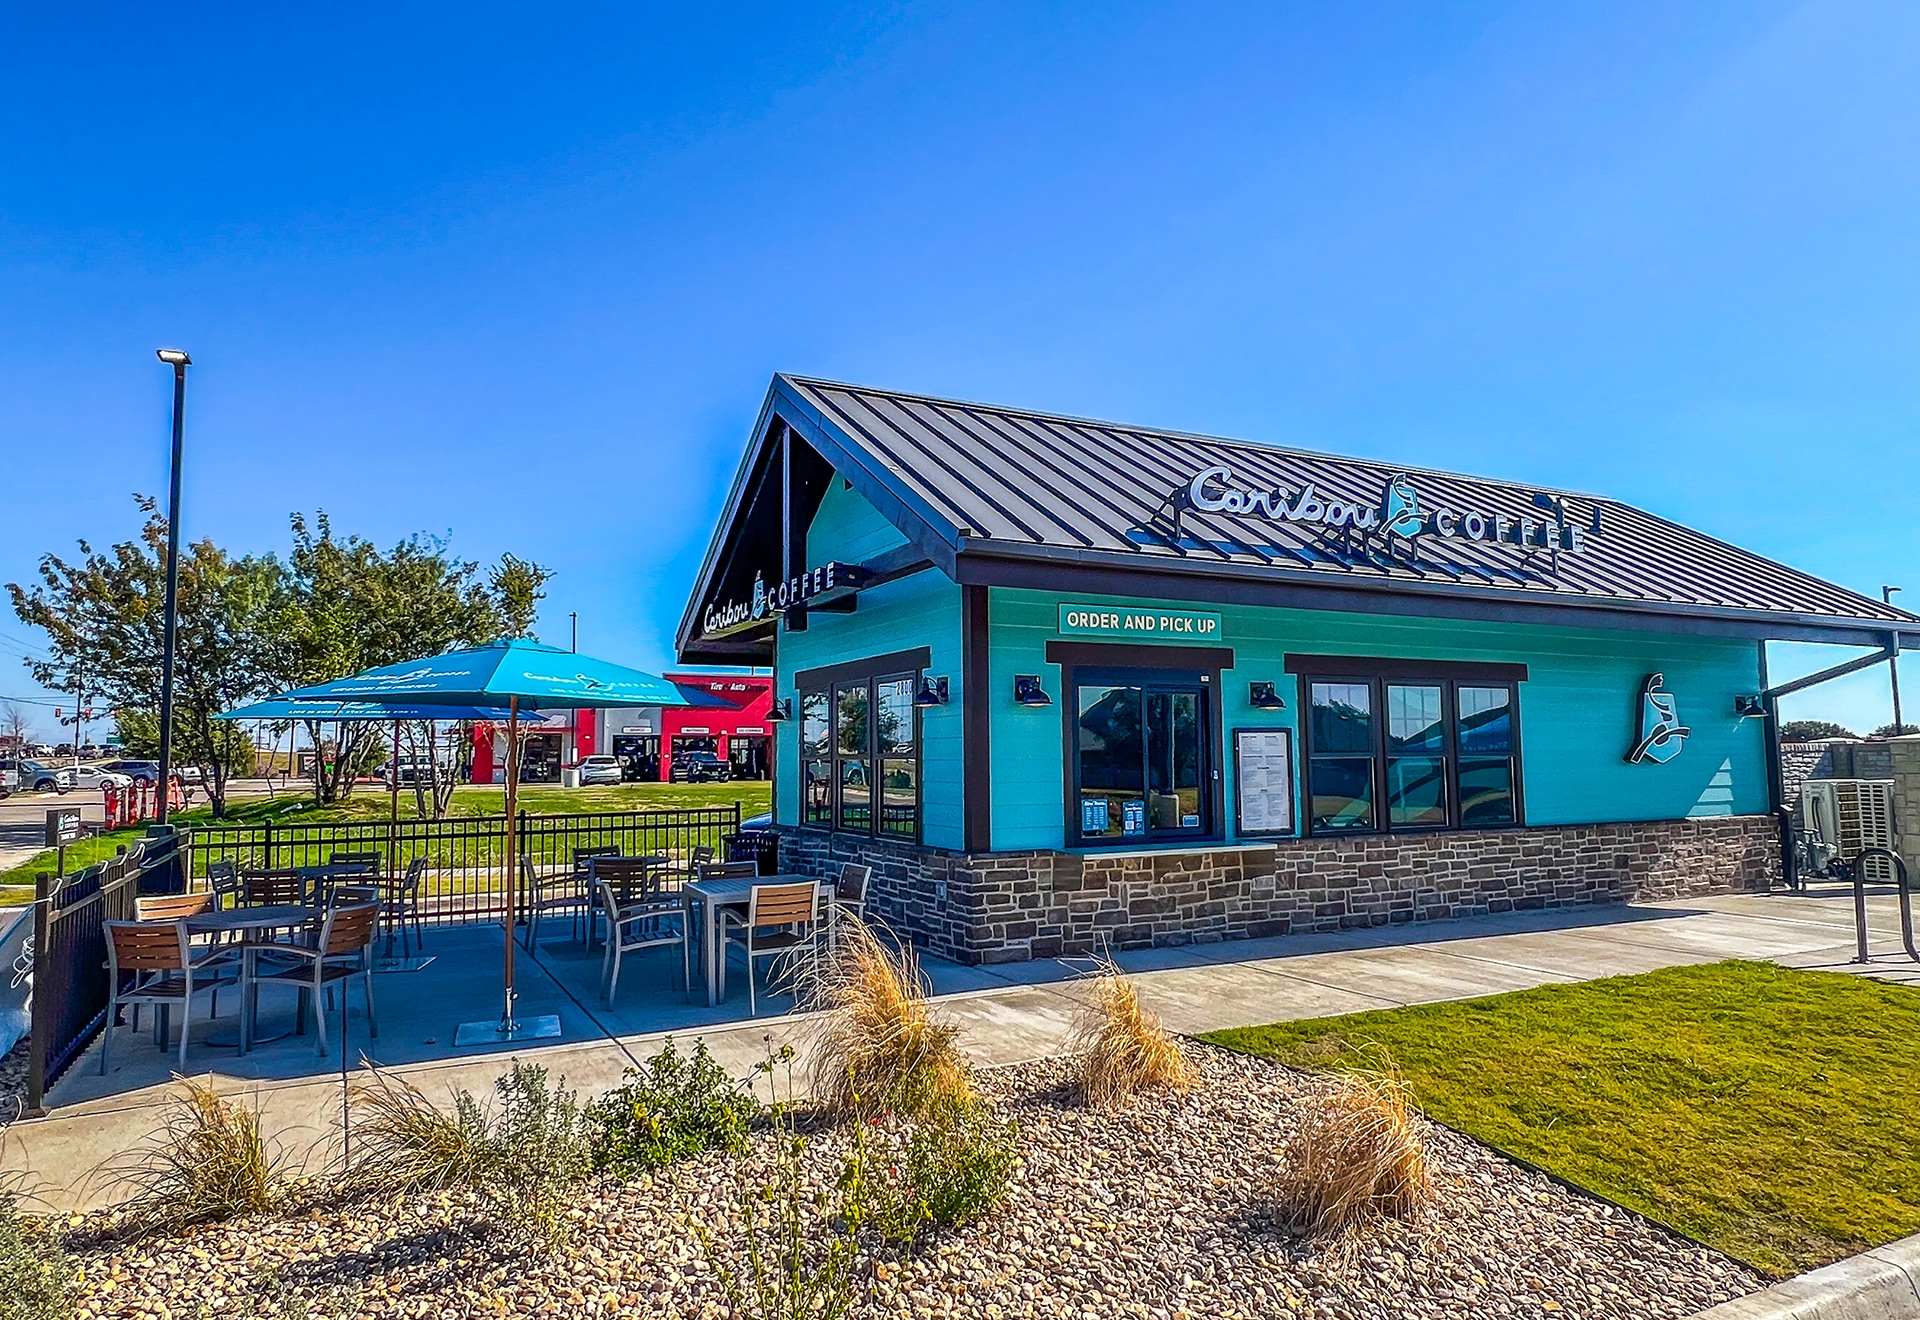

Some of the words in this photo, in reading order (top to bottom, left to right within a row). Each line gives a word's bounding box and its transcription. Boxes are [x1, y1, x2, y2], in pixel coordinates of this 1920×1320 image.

[1189, 465, 1380, 530] Caribou
[1437, 507, 1586, 552] COFFEE
[704, 599, 749, 633] Caribou
[768, 561, 835, 610] COFFEE
[1067, 611, 1119, 629] ORDER
[1124, 614, 1155, 631] AND
[1160, 616, 1193, 633] PICK
[1198, 618, 1216, 633] UP
[730, 682, 746, 692] Auto
